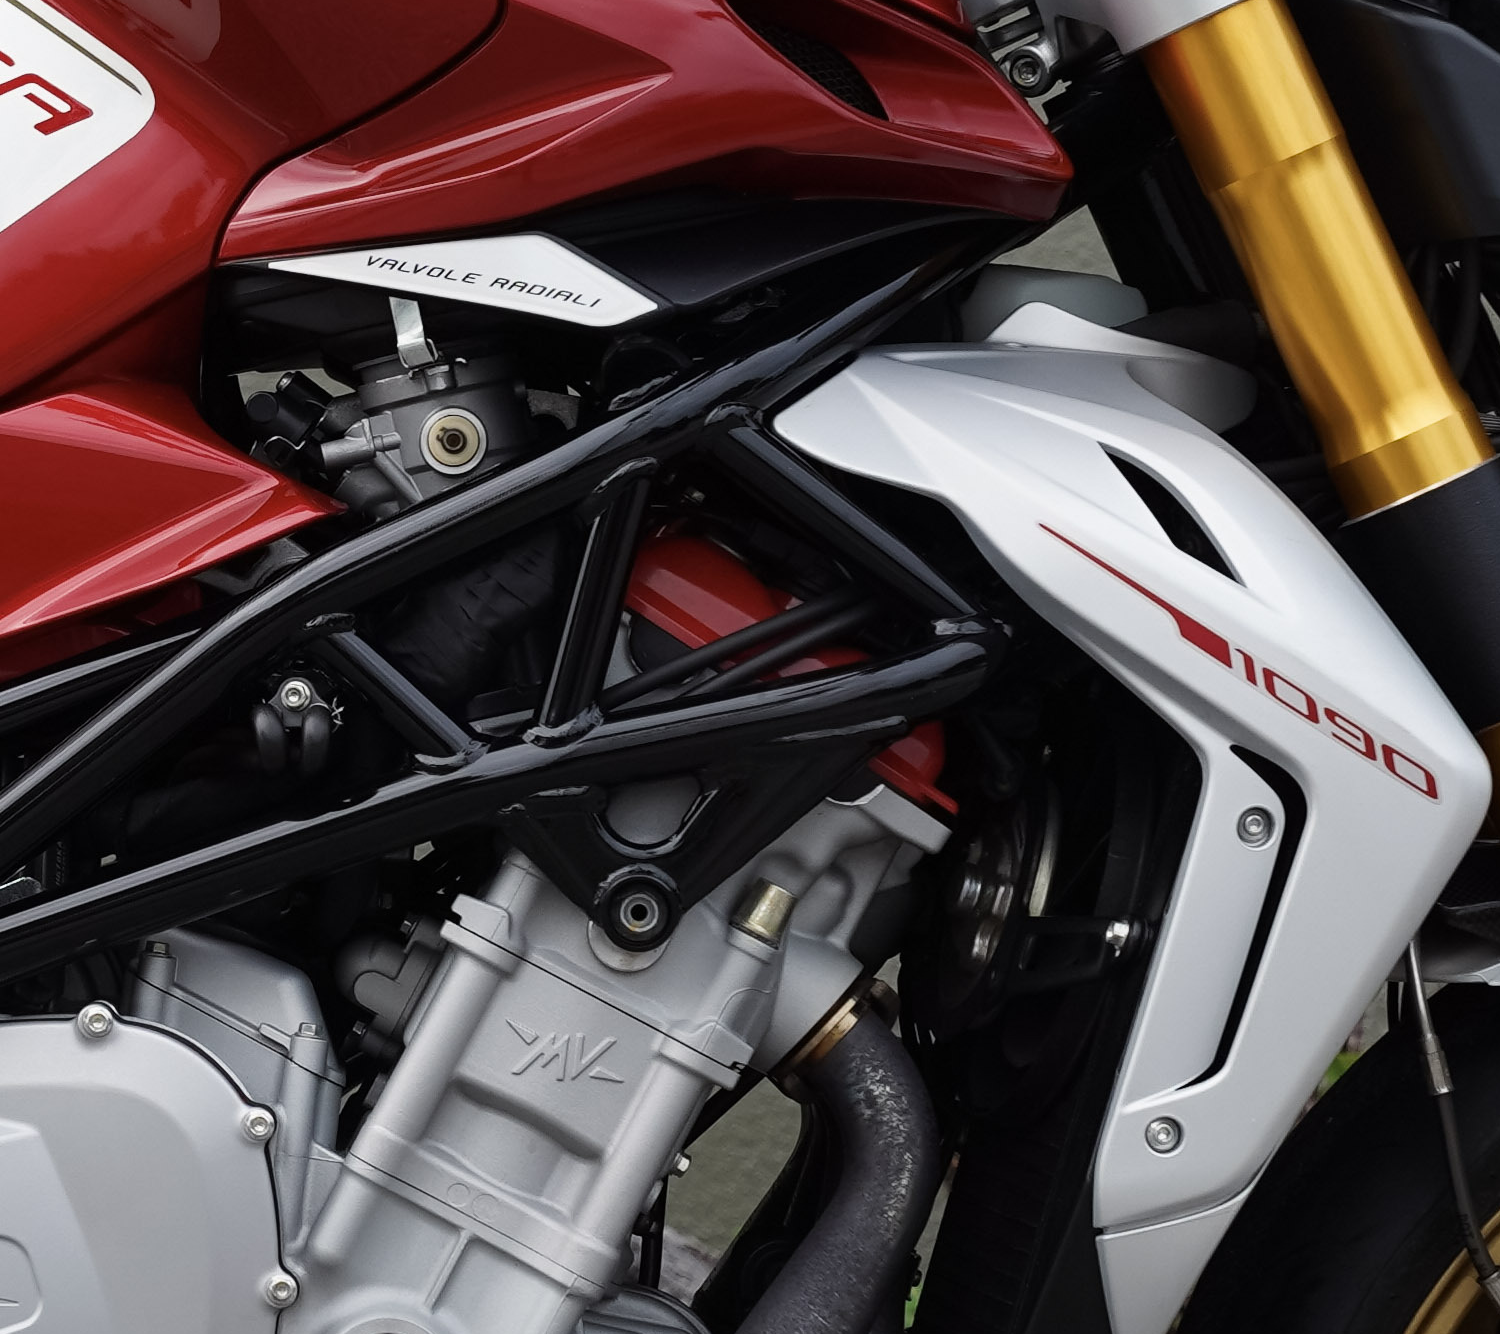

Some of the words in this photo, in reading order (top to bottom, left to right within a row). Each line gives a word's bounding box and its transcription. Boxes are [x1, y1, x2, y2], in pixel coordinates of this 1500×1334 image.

[366, 255, 482, 284] VALVOLE
[489, 277, 603, 308] RADIALI
[1234, 648, 1440, 800] 1090
